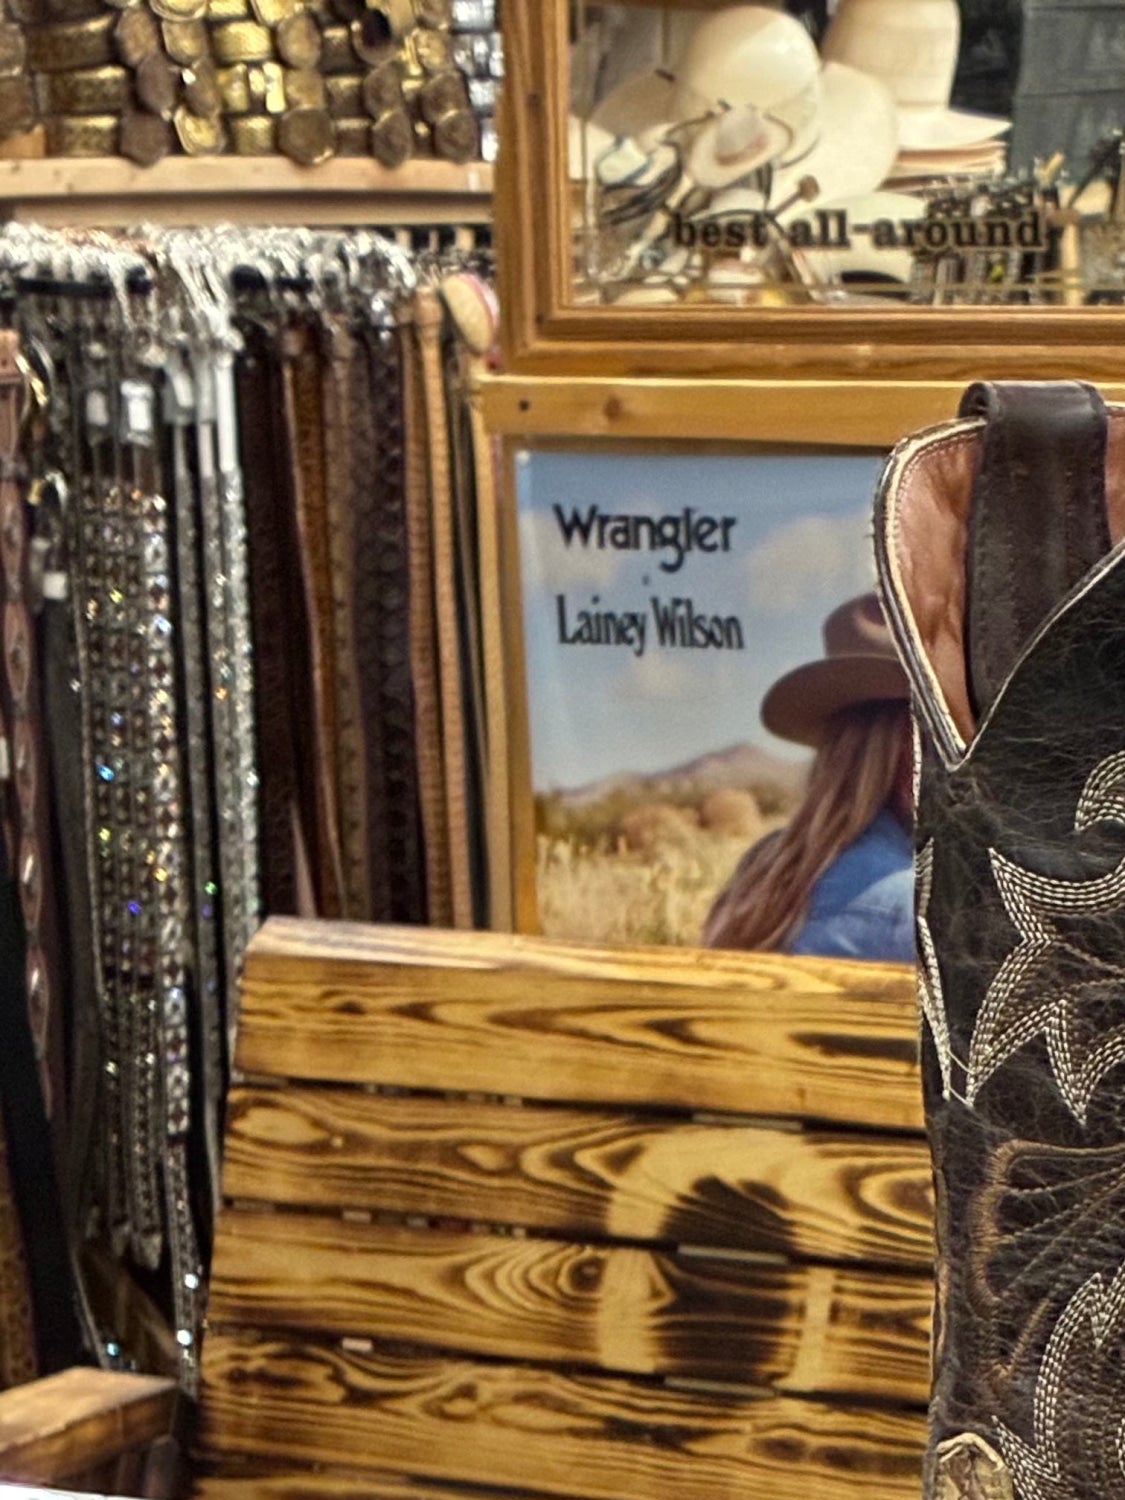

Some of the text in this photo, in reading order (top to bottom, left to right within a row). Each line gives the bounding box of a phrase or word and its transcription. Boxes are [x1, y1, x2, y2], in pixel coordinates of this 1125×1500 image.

[672, 208, 1046, 248] best all-around
[553, 502, 737, 573] Wrangler
[556, 593, 745, 657] Lainey Wilson
